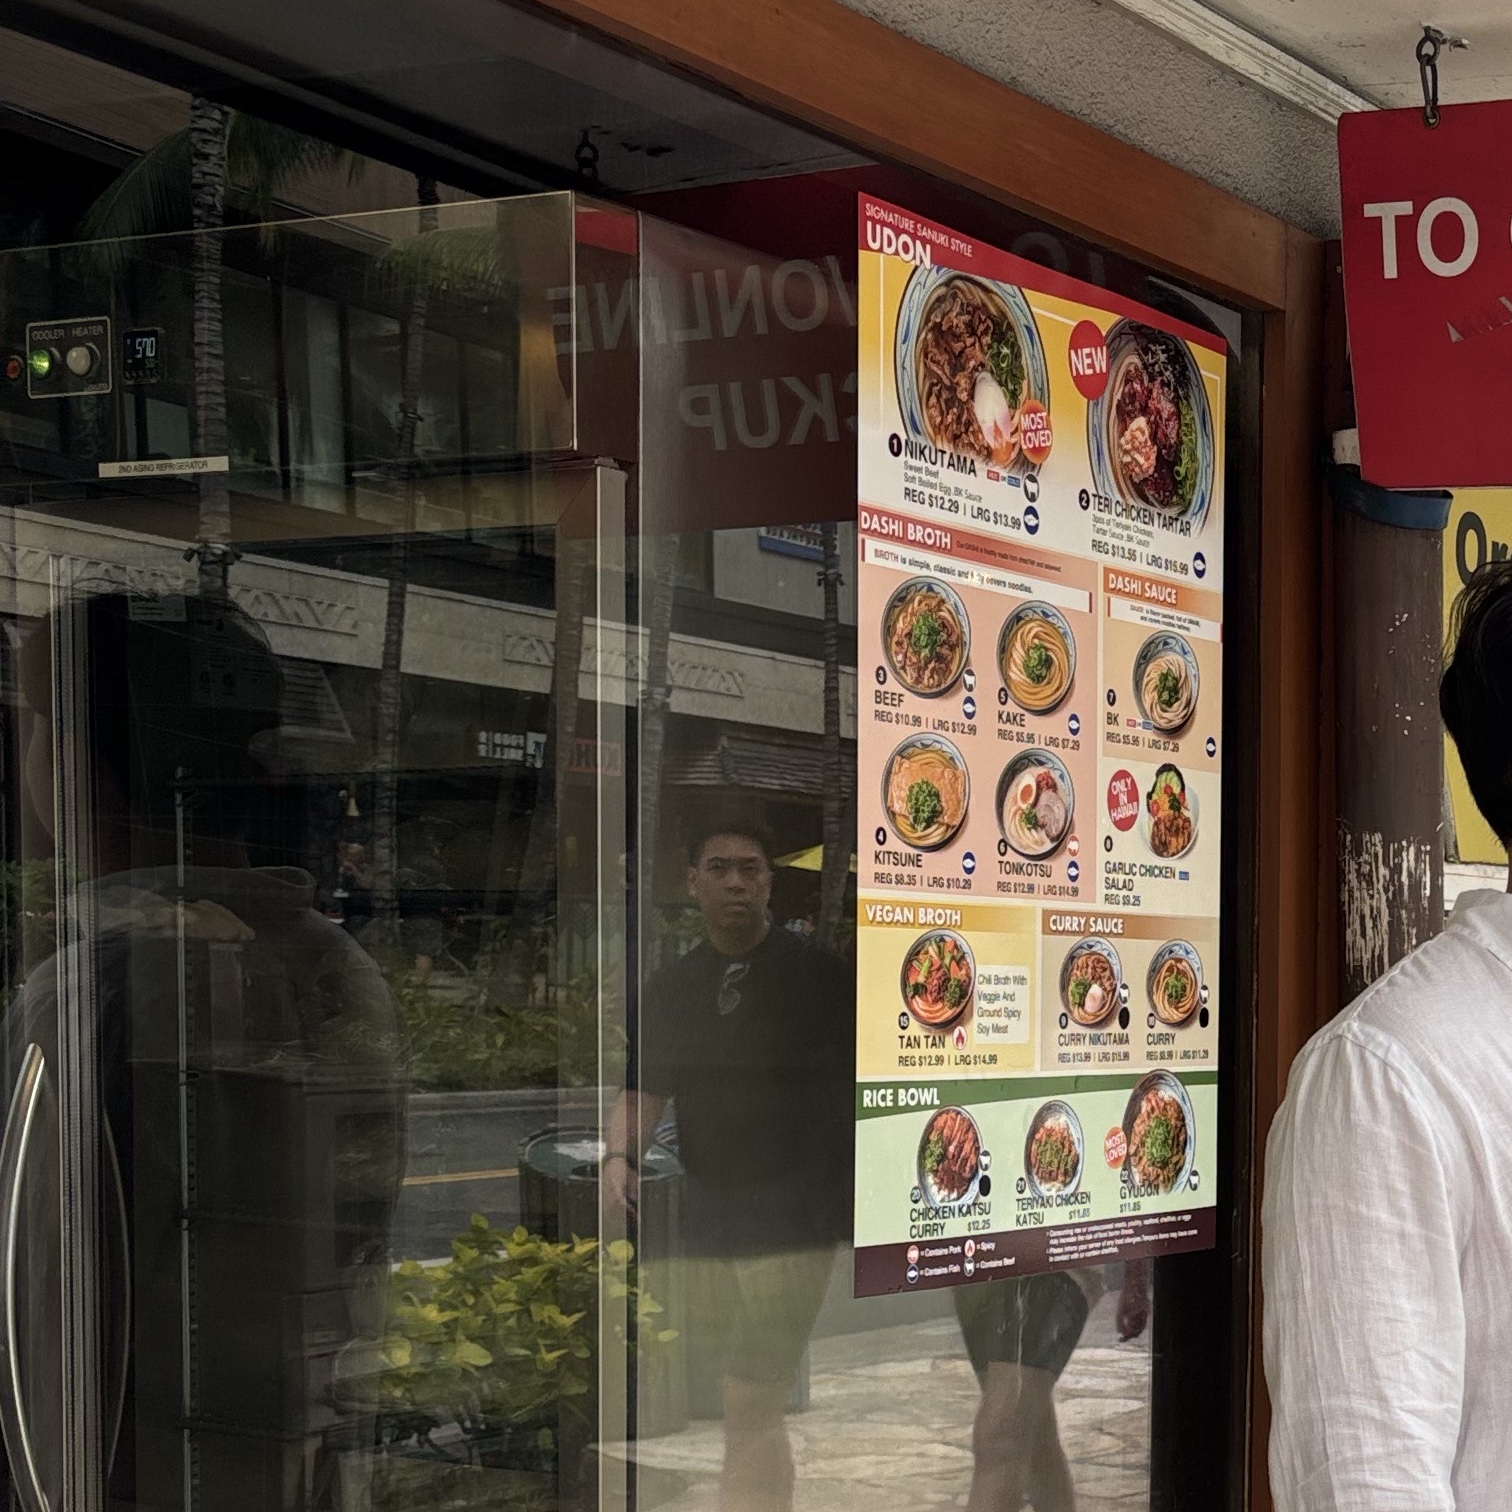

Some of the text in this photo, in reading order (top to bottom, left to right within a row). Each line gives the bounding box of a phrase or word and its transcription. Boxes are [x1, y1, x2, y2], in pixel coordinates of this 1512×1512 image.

[865, 202, 974, 258] SIGNATURE SANUKI STYLE
[1363, 197, 1479, 281] TO
[866, 220, 932, 270] UDON
[31, 325, 104, 341] COOLER HEATER
[1070, 346, 1107, 377] NEW
[1020, 412, 1047, 430] MOST
[1020, 430, 1052, 449] LOVED
[904, 439, 977, 477] NIKUTAMA
[904, 460, 939, 479] Sweet Beef
[904, 471, 916, 484] Soft
[918, 476, 937, 491] Boiled
[904, 487, 1021, 531] REG $12.29 LRG $13.99
[1092, 493, 1191, 538] TERI CHICKEN TARTAR
[860, 511, 951, 550] DASHI BROTH
[874, 548, 899, 564] BROTH
[900, 554, 906, 564] is
[1091, 539, 1189, 575] REG LRG $15.99
[1108, 573, 1178, 605] DASHI SAUCE
[874, 689, 905, 708] BEEF
[874, 709, 977, 737] REG $10.99 LRG $12.99
[997, 709, 1026, 728] KAKE
[1106, 712, 1120, 727] BK
[997, 728, 1014, 743] REG
[1044, 735, 1060, 749] LRG
[1061, 738, 1080, 752] $7.29
[1106, 731, 1162, 750] REG LRG
[1111, 776, 1132, 796] ONLY
[1118, 792, 1128, 807] IN
[1111, 801, 1139, 822] HAWAII
[874, 850, 923, 868] KITSUNE
[998, 860, 1052, 878] TONKOTSU
[1104, 861, 1176, 880] GARLIC CHICKEN
[873, 872, 972, 891] REG $8.35 LRG $10.29
[997, 881, 1012, 893] REG
[1043, 884, 1057, 896] LRG
[1104, 877, 1134, 892] SALAD
[1104, 894, 1121, 906] REG
[865, 904, 962, 926] VEGAN BROTH
[1050, 915, 1124, 934] CURRY SAUCE
[977, 974, 1027, 986] Chili Broth With
[977, 990, 1015, 1004] Veggie And
[976, 1007, 1021, 1020] Ground Spicy
[976, 1024, 1009, 1036] Soy Meat
[1146, 1032, 1176, 1046] CURRY
[898, 1034, 946, 1050] TAN TAN
[1057, 1033, 1130, 1047] CURRY NIKUTAMA
[898, 1053, 998, 1068] REG $12.99 LRG $14.99
[1058, 1052, 1111, 1063] REG LRG
[862, 1087, 940, 1108] RICE BOWL
[1105, 1132, 1124, 1149] MOST
[1105, 1144, 1127, 1163] LOVED
[1120, 1184, 1160, 1199] GYUDON
[1016, 1191, 1091, 1212] TERIYAKI CHICKEN
[909, 1201, 991, 1222] CHICKEN KATSU
[1015, 1210, 1045, 1227] KATSU
[909, 1219, 991, 1239] CURRY $12.25
[980, 1242, 996, 1252] Spicy
